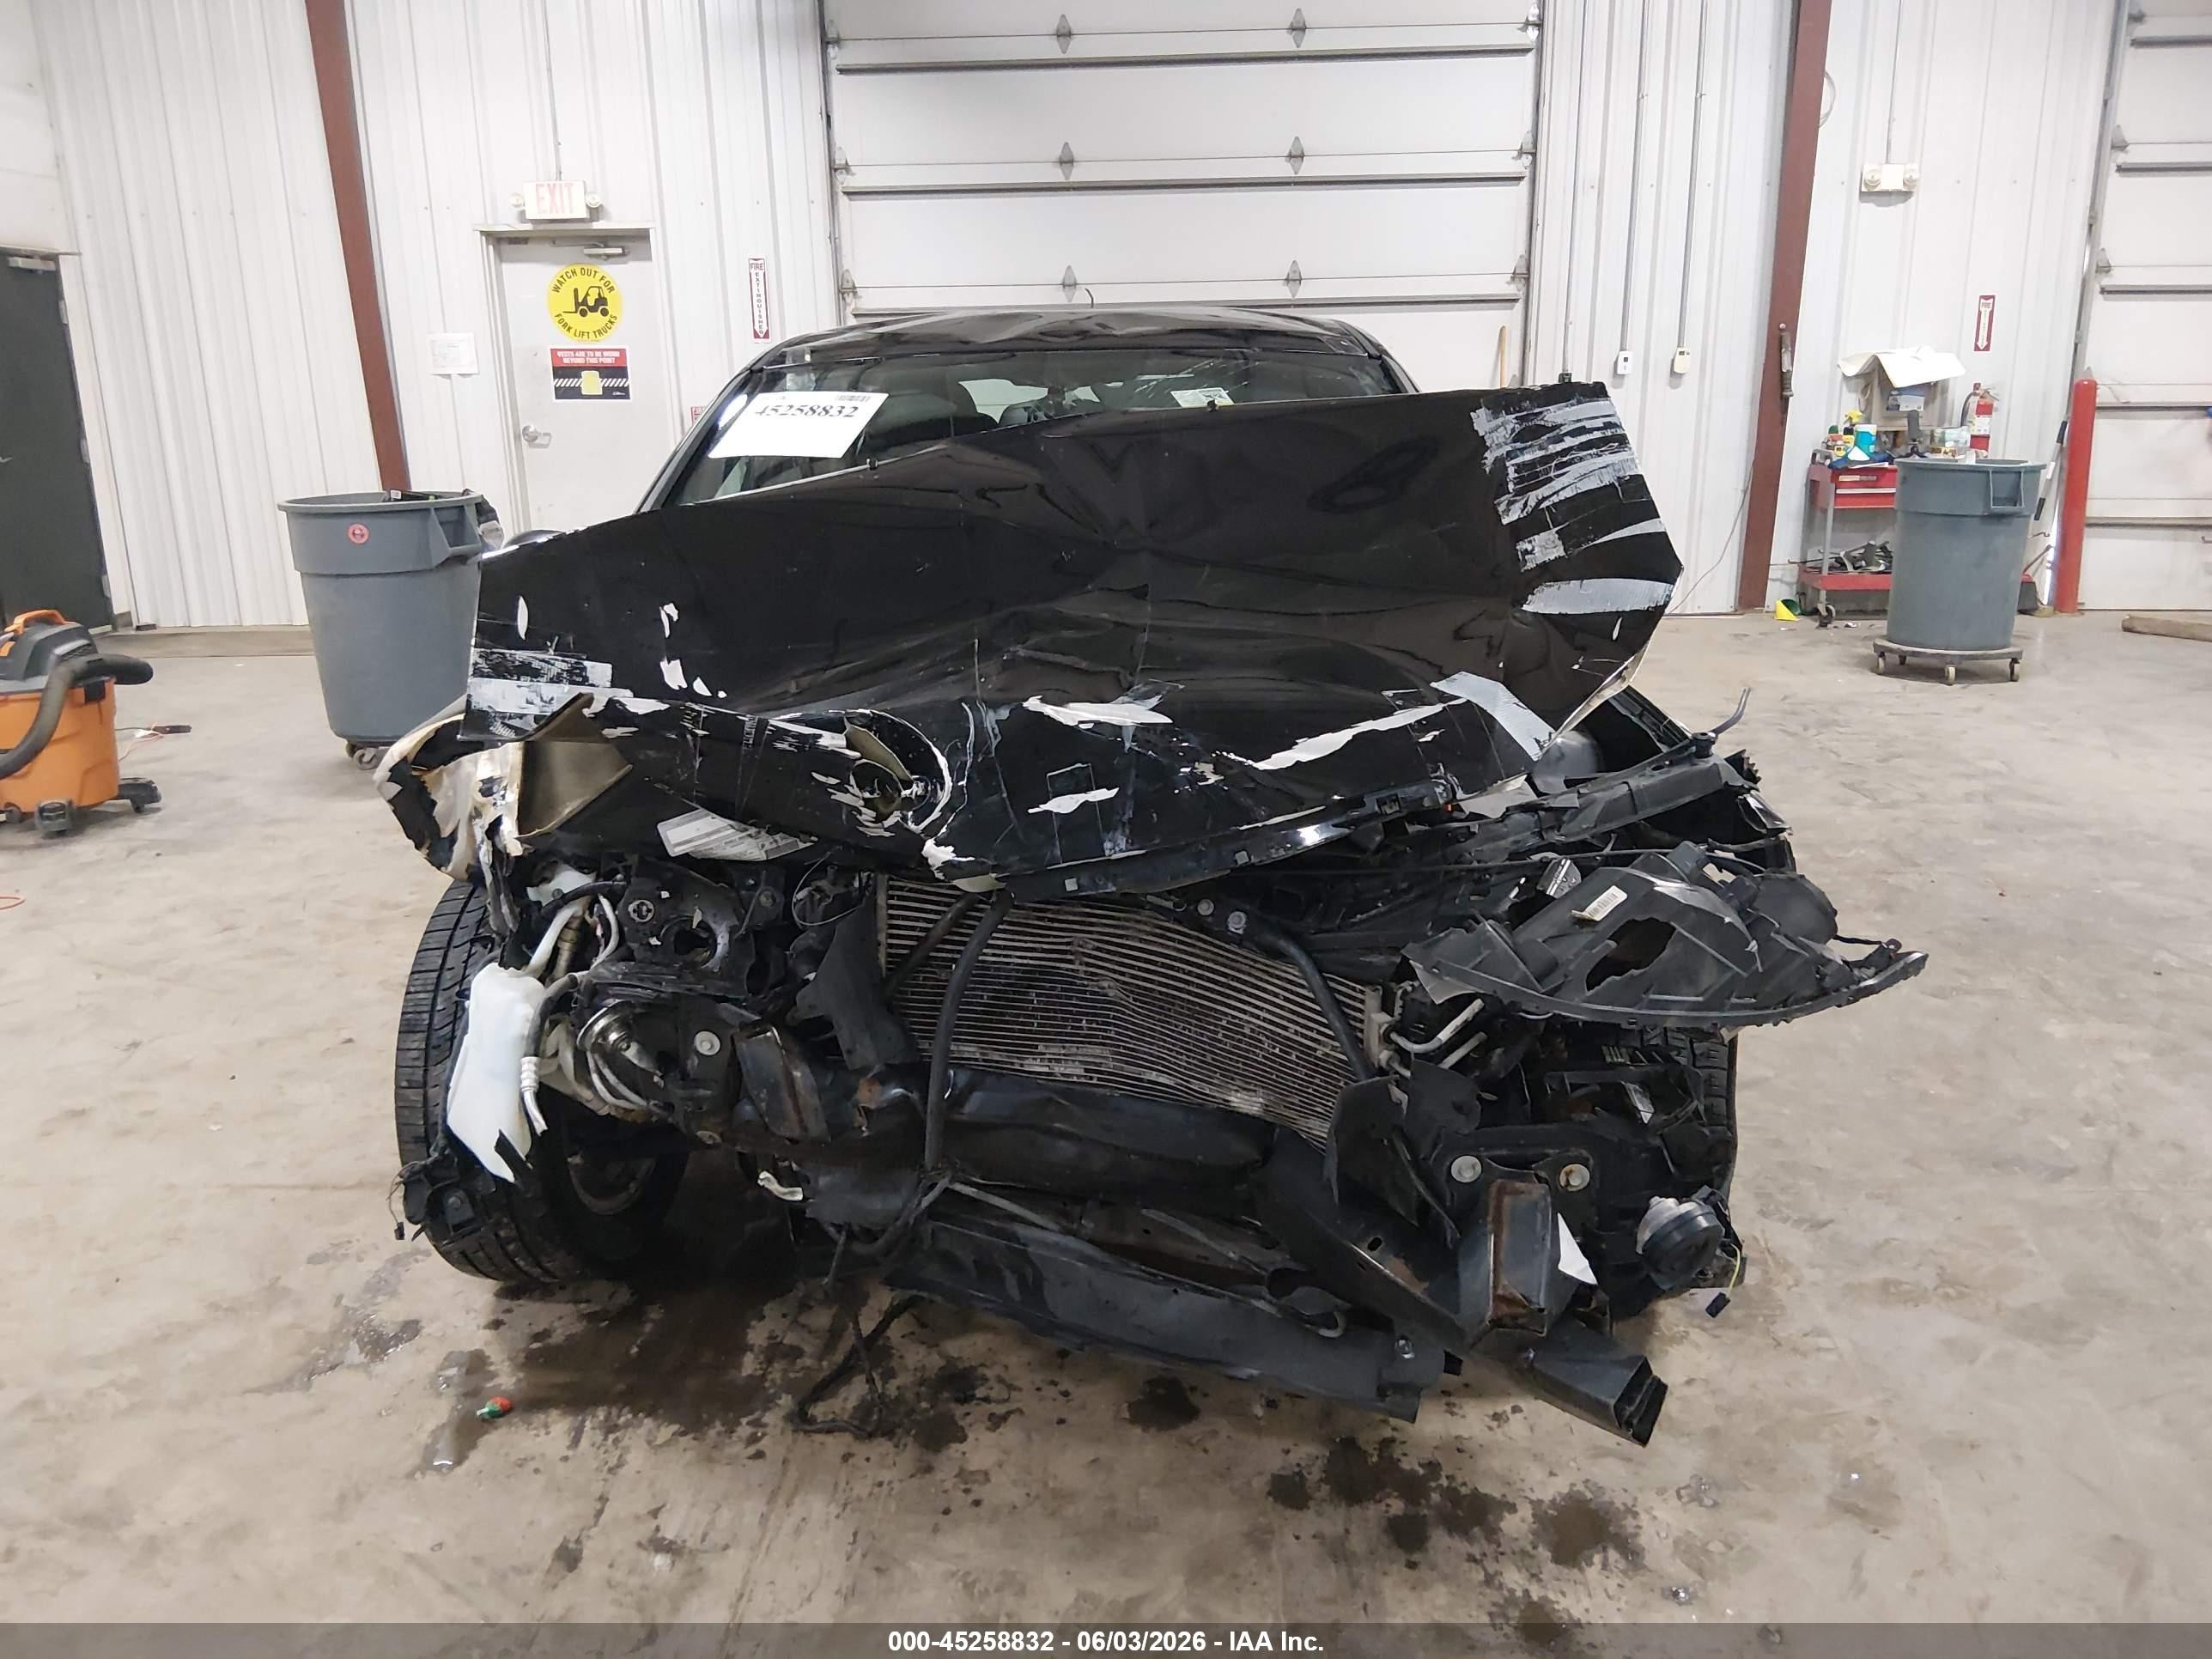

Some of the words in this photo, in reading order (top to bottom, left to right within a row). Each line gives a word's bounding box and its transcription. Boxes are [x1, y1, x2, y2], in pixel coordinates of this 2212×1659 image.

[536, 183, 574, 214] EXIT
[551, 268, 578, 293] WATCH
[580, 267, 598, 278] OUT
[599, 275, 615, 293] FOR
[554, 313, 573, 333] FORK
[574, 328, 590, 339] LIFT
[592, 314, 617, 338] TRUCKS
[755, 404, 860, 418] 45258832
